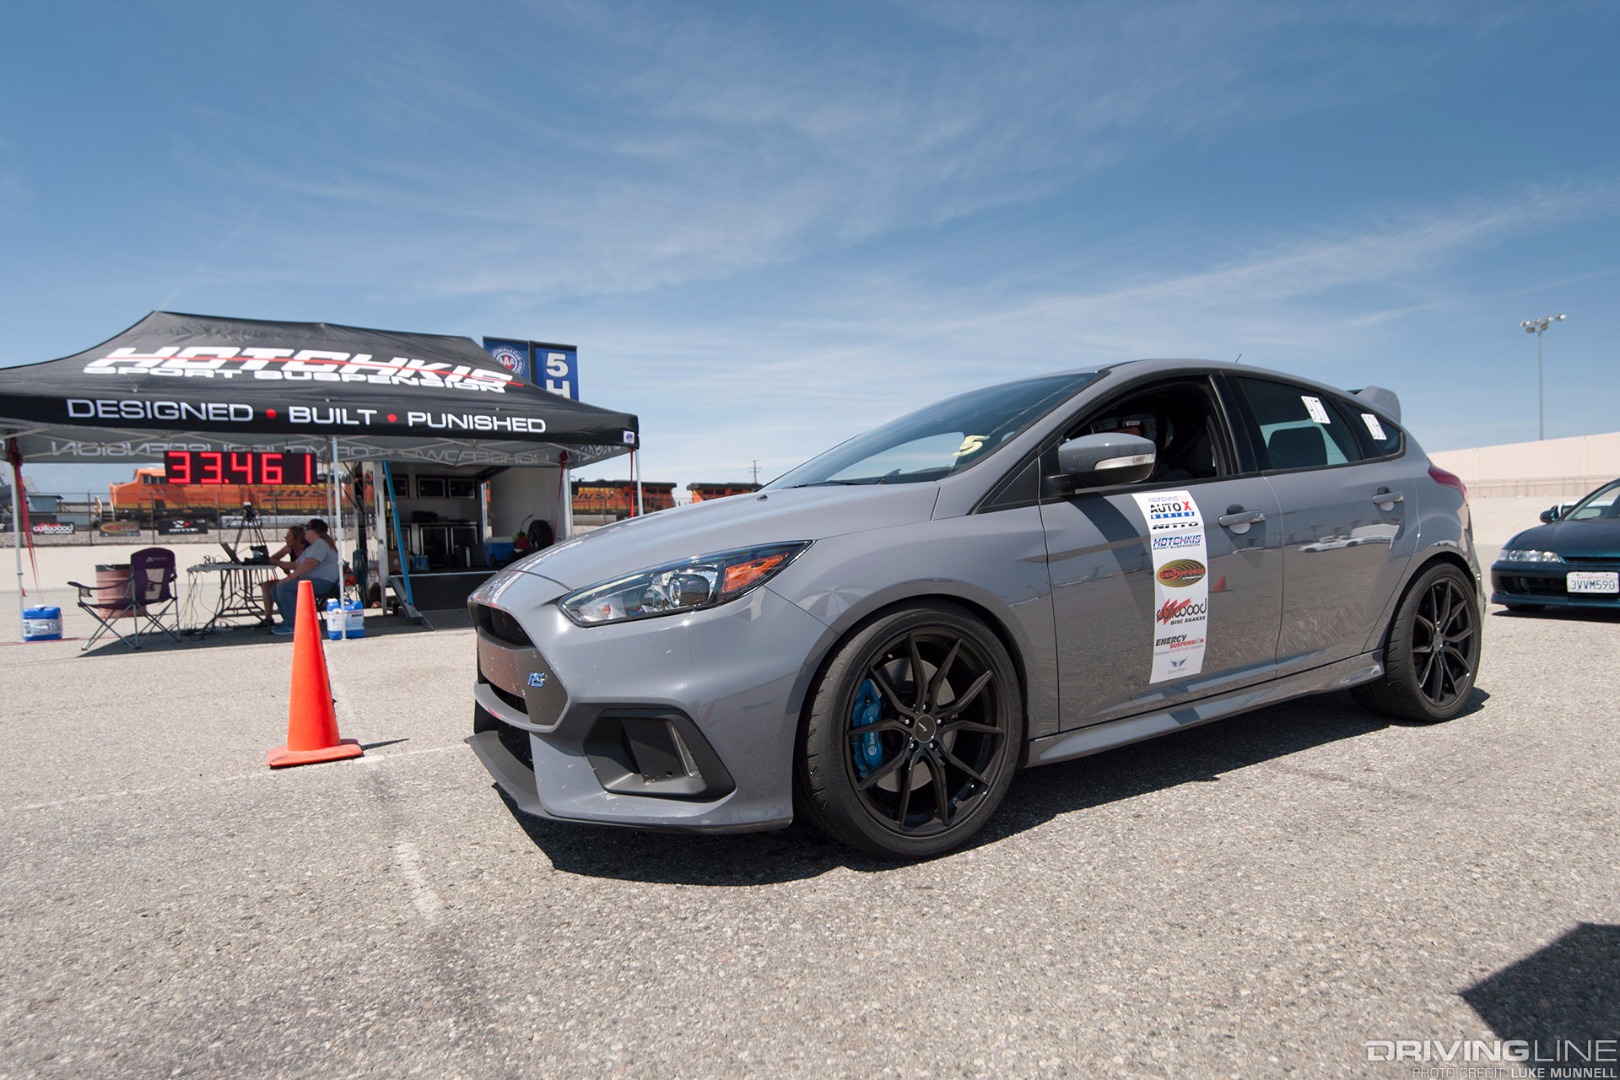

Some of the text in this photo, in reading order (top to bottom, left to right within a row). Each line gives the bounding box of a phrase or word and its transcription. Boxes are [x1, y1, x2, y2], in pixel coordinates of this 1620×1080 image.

[87, 346, 513, 387] HOTCHKIS
[83, 366, 506, 394] SPORT SUSPENSION
[66, 399, 547, 434] DESIGNED BUILT PUNISHED
[952, 434, 990, 457] 5
[1150, 500, 1192, 513] AUTO X
[1153, 534, 1202, 547] HOTCHKIS
[1570, 580, 1615, 590] 3VVM590
[1155, 634, 1187, 647] ENERGY
